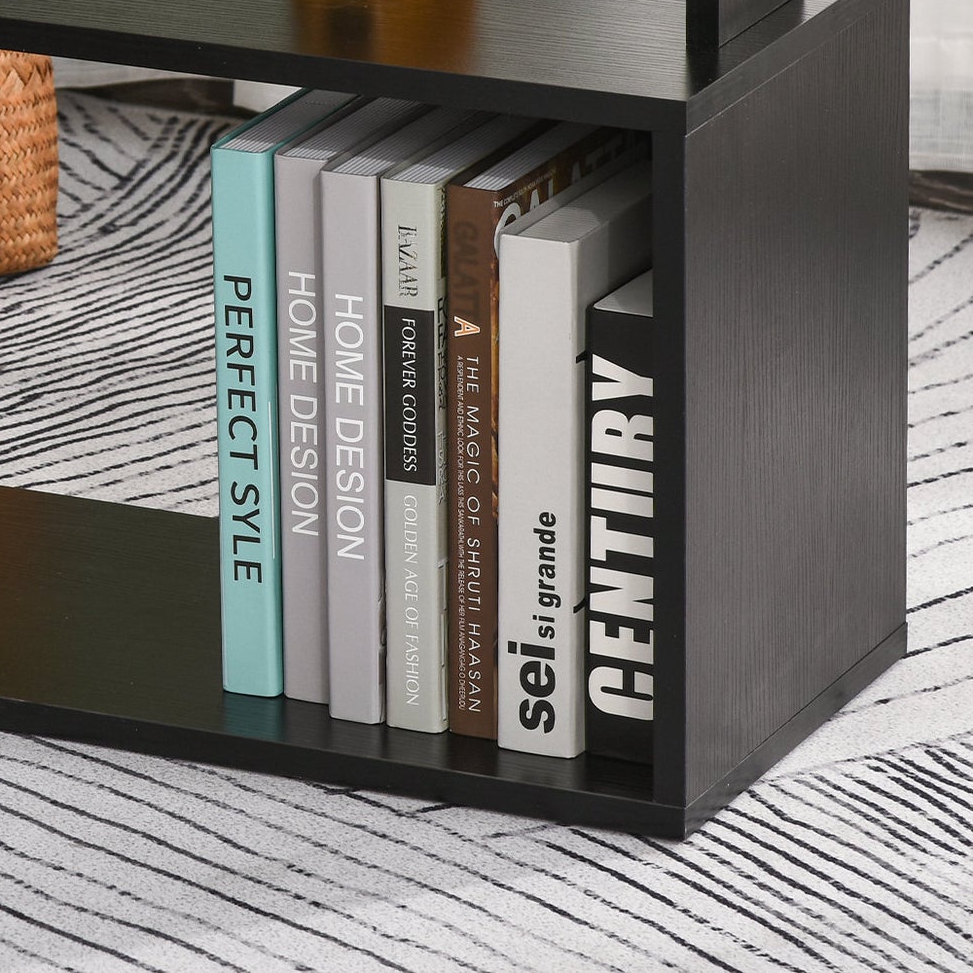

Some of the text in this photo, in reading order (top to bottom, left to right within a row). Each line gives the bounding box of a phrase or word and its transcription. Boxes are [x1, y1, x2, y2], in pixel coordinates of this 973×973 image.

[224, 275, 262, 583] PERFECT SYLE
[288, 271, 317, 383] HOME
[334, 294, 364, 406] HOME
[401, 317, 418, 472] FOREVER GODDESS
[403, 494, 420, 706] GOLDEN AGE OF FASHION
[466, 356, 482, 712] THE MAGIC OF SHRUTI HAASAN
[508, 511, 562, 735] sei si grande
[588, 353, 654, 721] CENTURY
